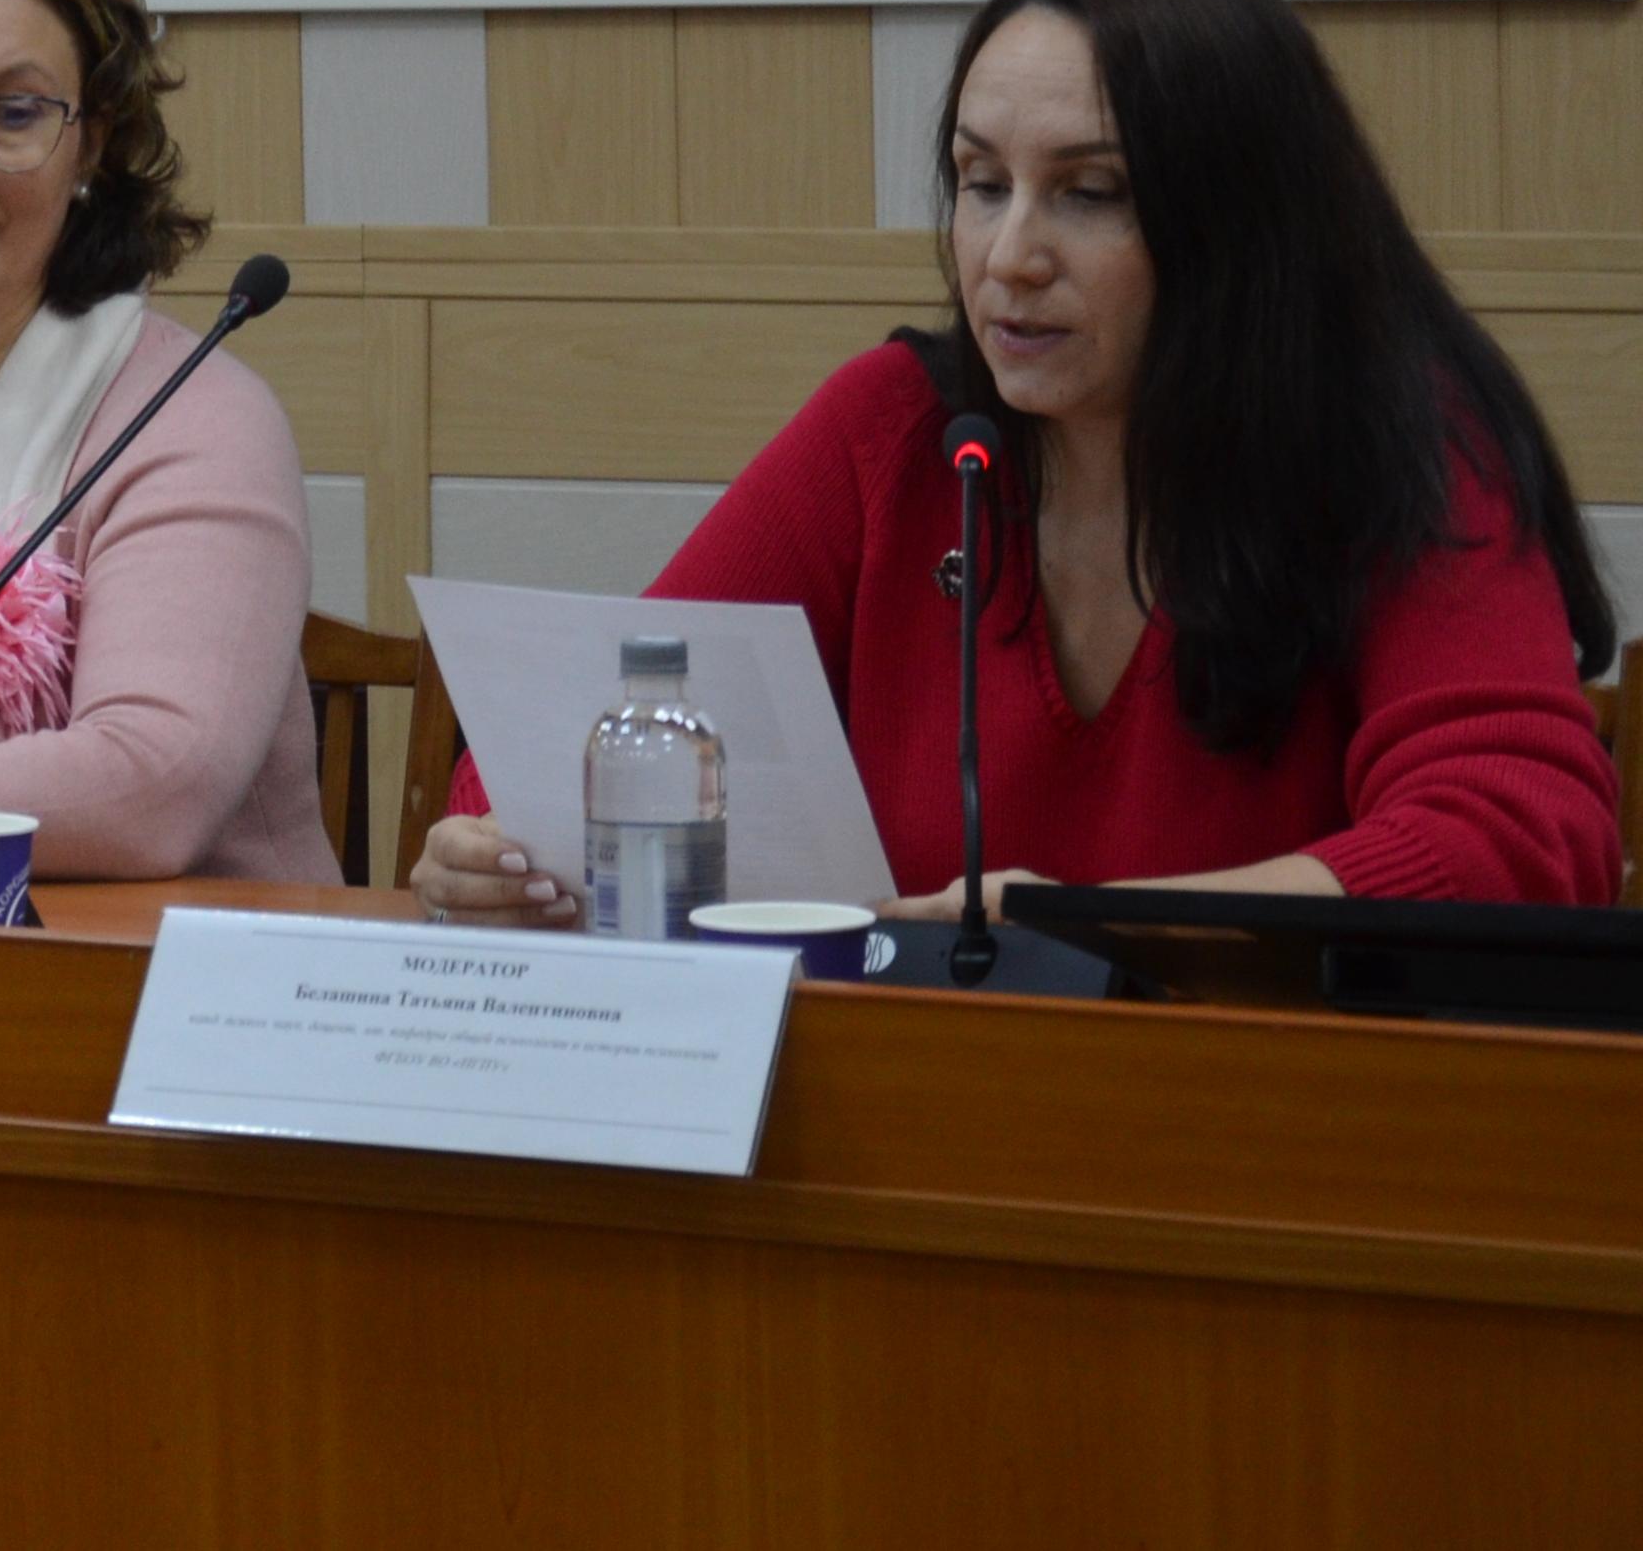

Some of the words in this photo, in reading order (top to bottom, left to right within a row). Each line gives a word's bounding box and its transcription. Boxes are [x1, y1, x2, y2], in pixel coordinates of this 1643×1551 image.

[400, 955, 530, 979] МОДЕРАТОР
[397, 990, 476, 1012] Татьяна
[482, 996, 622, 1023] Валентиновна
